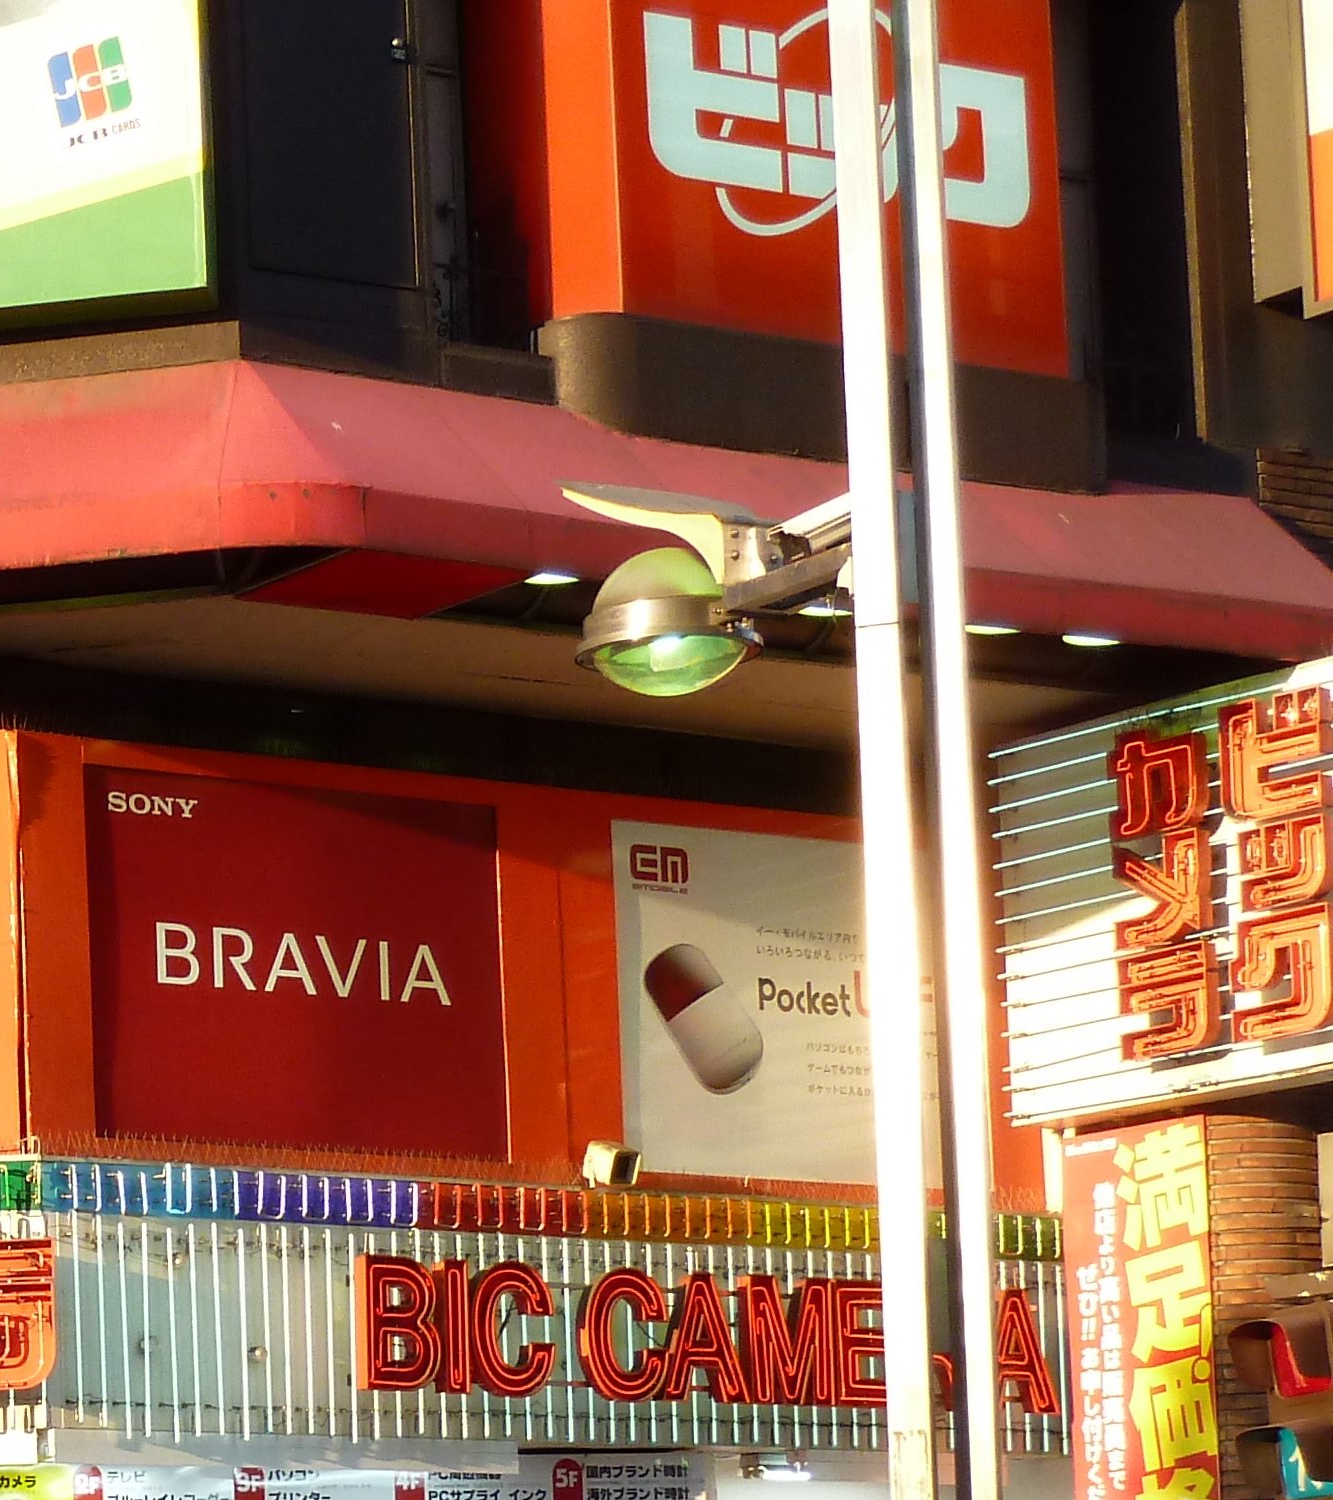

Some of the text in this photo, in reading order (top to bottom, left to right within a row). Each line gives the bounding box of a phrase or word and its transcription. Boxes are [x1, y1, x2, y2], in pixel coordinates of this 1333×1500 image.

[53, 64, 128, 100] JCB
[111, 118, 142, 135] CARDS
[107, 791, 199, 819] SONY
[154, 922, 452, 1007] BRAVIA
[758, 978, 852, 1018] Pocket
[355, 1253, 1059, 1415] BIC CAMEA
[106, 1470, 147, 1484] テレビ
[555, 1468, 578, 1488] 5F
[586, 1465, 688, 1479] 国内ブランド時計
[587, 1487, 689, 1500] 海外ブランド時計
